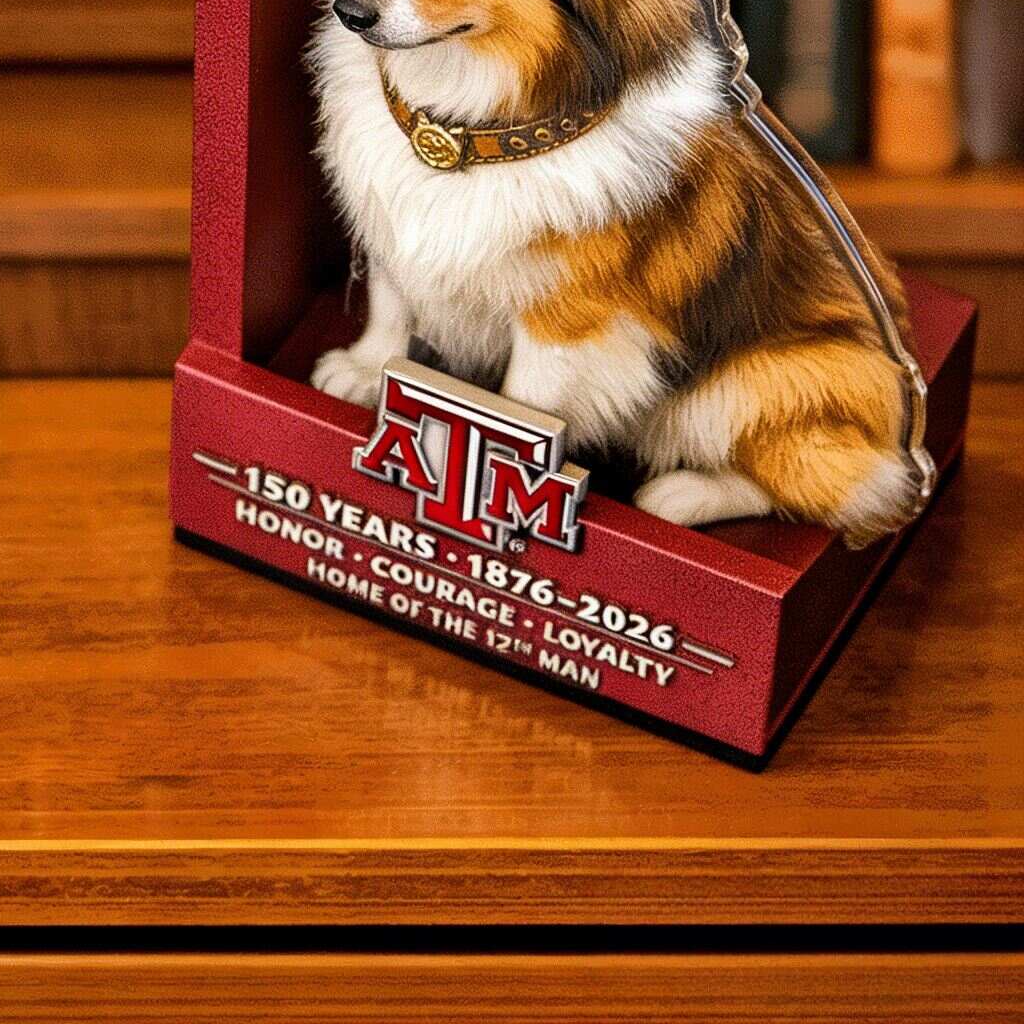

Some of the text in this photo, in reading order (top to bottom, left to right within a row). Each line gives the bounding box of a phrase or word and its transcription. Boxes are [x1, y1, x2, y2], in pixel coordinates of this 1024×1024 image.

[243, 466, 311, 511] 150
[319, 493, 436, 560] YEARS
[235, 499, 675, 687] HONOR COURAGE LOYALTY
[307, 557, 386, 606] HOME
[389, 592, 424, 619] OF
[427, 606, 479, 641] THE
[538, 648, 600, 690] MAN
